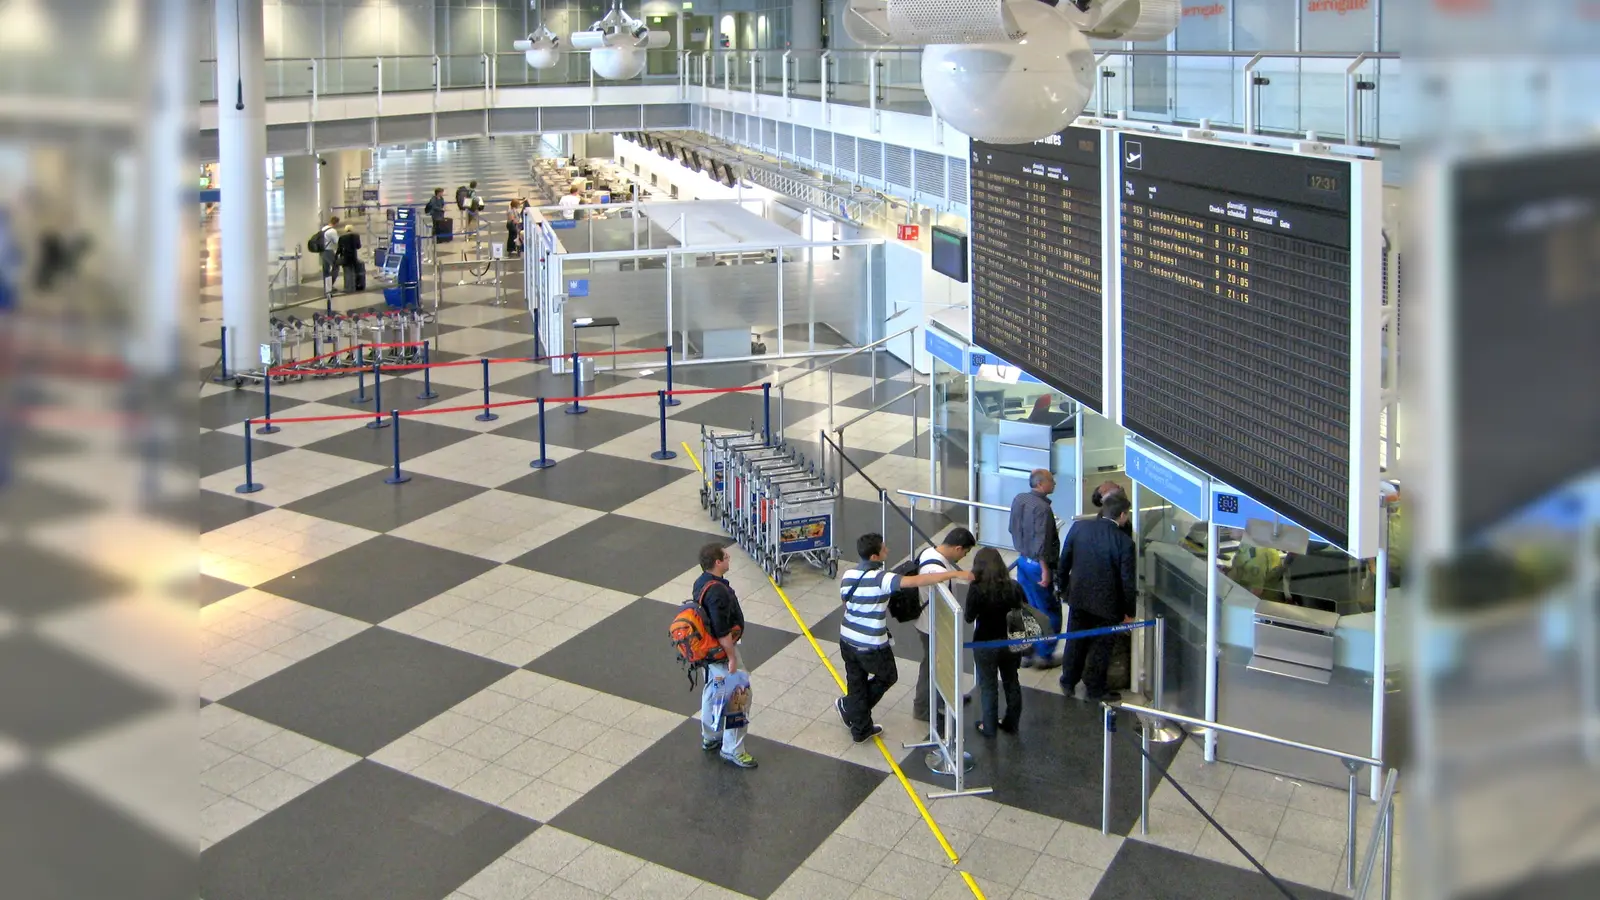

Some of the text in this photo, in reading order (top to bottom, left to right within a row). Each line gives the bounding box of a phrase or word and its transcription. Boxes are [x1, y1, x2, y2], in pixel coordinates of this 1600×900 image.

[1308, 0, 1369, 15] aerogate
[1133, 205, 1143, 215] 953
[1228, 228, 1249, 240] 16:15
[1133, 218, 1143, 228] 955
[1228, 242, 1249, 256] 17:30
[1228, 258, 1249, 272] 19:10
[1228, 273, 1249, 288] 20:05
[1228, 288, 1249, 304] 21:15
[1222, 500, 1233, 508] EU
